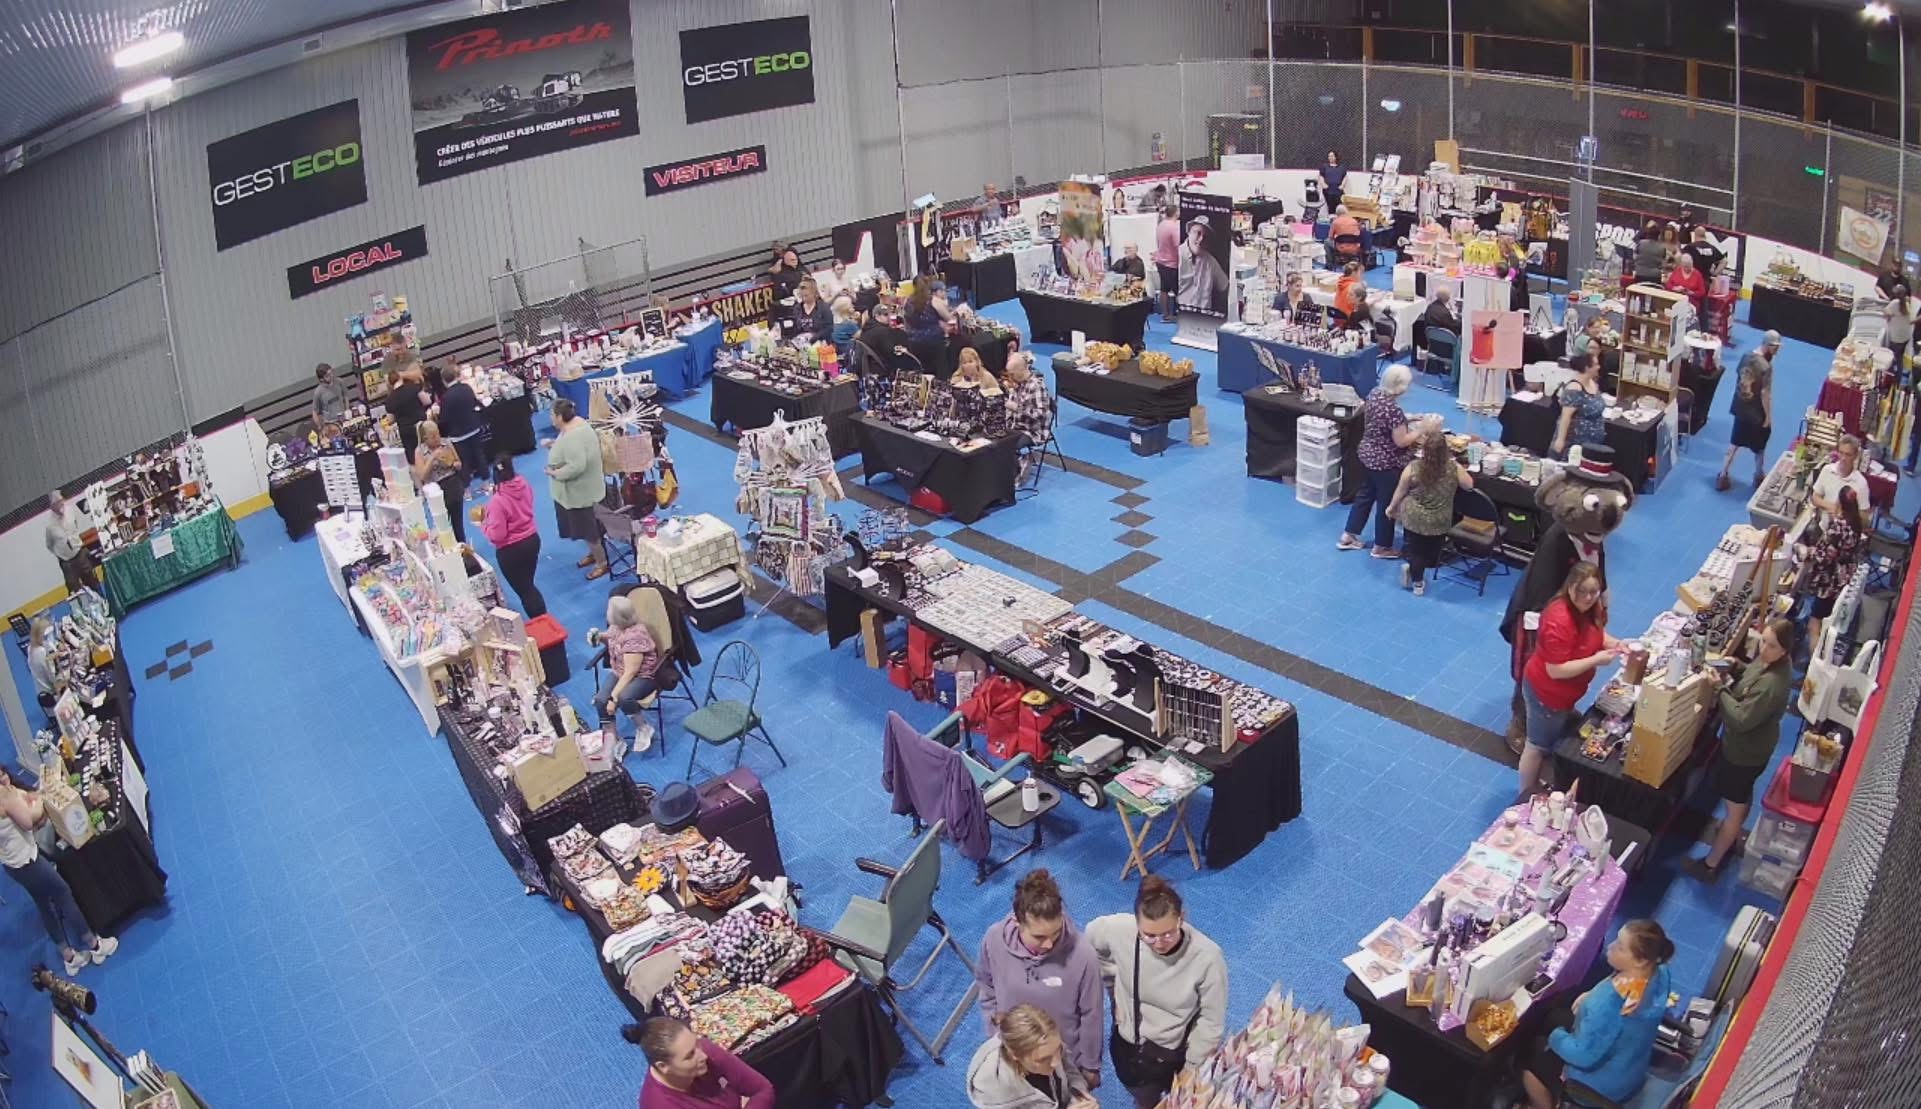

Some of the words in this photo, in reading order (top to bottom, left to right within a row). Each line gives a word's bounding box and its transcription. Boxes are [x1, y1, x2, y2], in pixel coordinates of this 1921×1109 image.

[428, 22, 612, 72] Prinoth
[685, 51, 810, 86] GESTECO
[213, 142, 360, 206] GESTECO
[652, 151, 760, 188] VISITEUR
[312, 242, 402, 284] LOCAL
[711, 286, 773, 324] SHAKER
